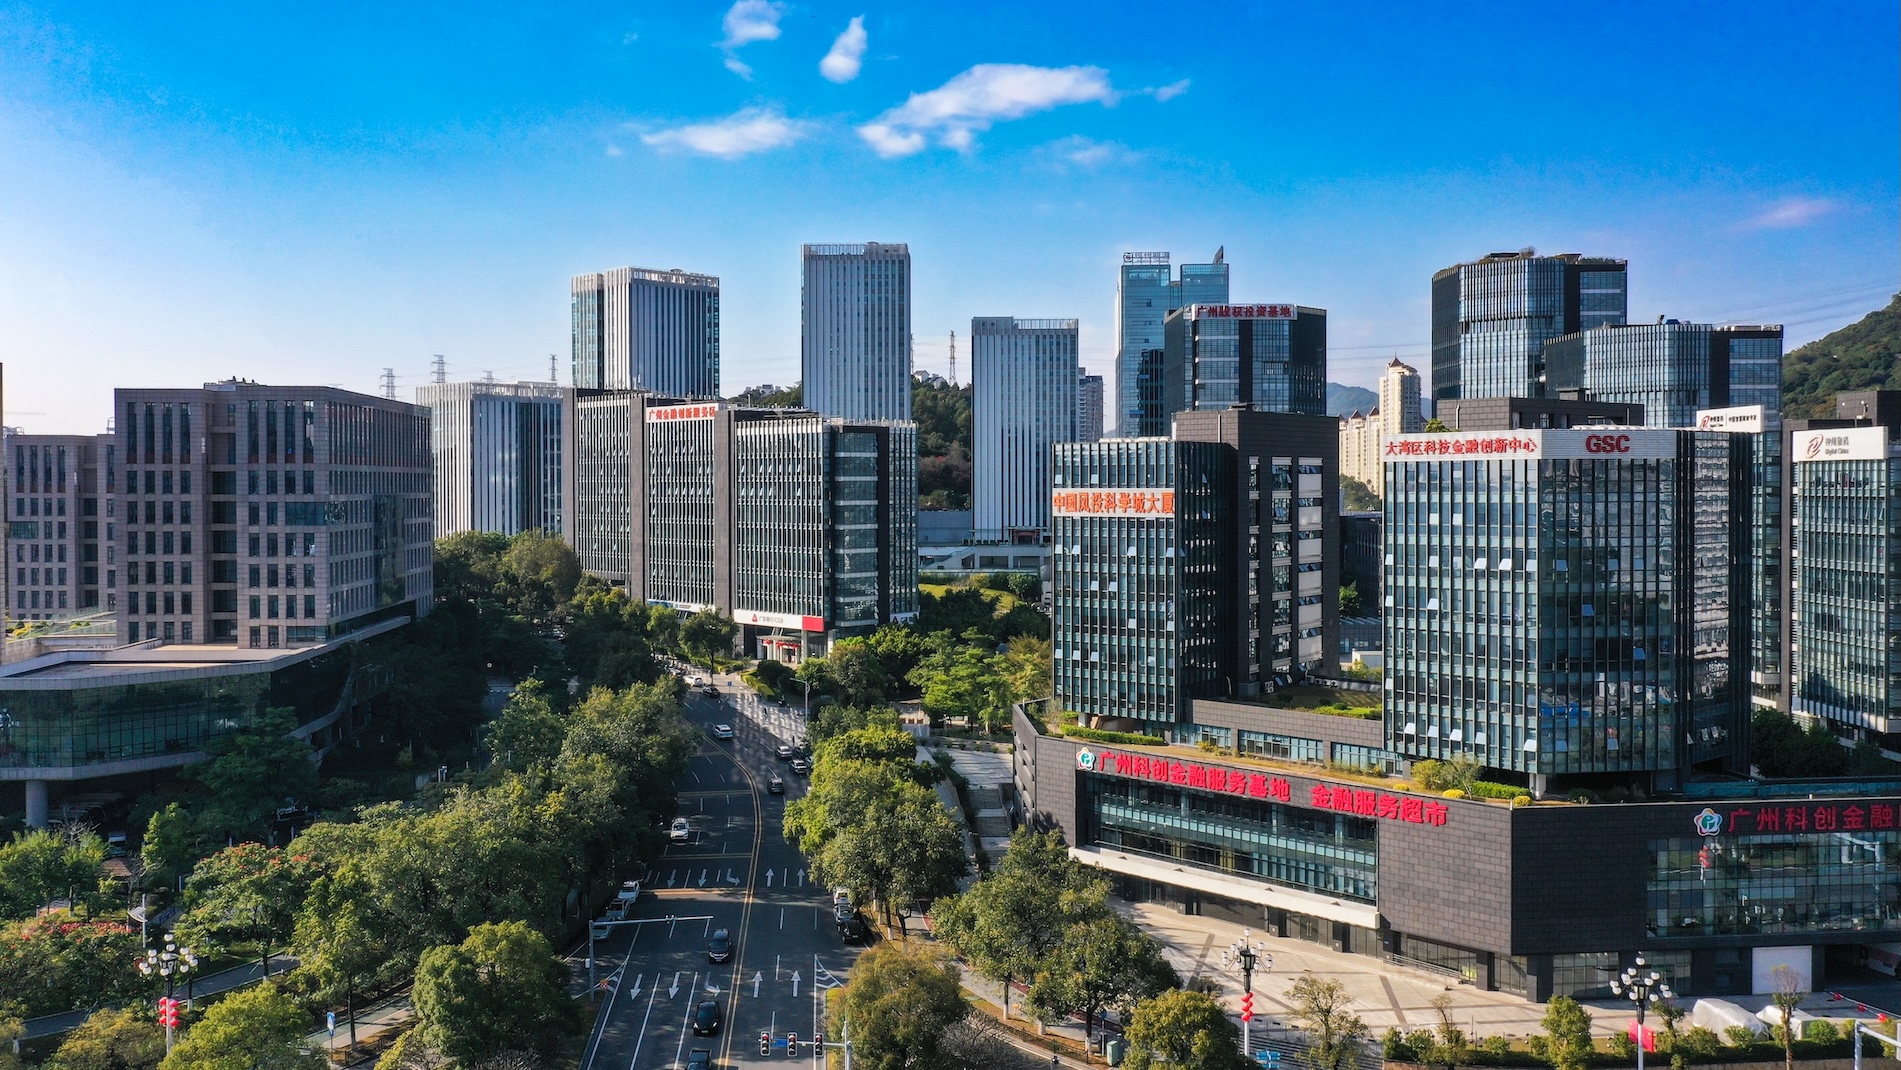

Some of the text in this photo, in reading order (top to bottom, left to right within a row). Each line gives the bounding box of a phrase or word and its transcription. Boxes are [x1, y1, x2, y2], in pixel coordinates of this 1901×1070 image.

[1196, 305, 1292, 318] 广州股权投资基地
[1385, 437, 1538, 456] 大湾区科技金融创新中心
[1585, 434, 1630, 453] GSC
[1053, 492, 1175, 514] 中国风投科学城大厦
[1099, 751, 1448, 826] 广州科创金融服务基地 金融服务超市
[1727, 804, 1901, 832] 广州科创金融
